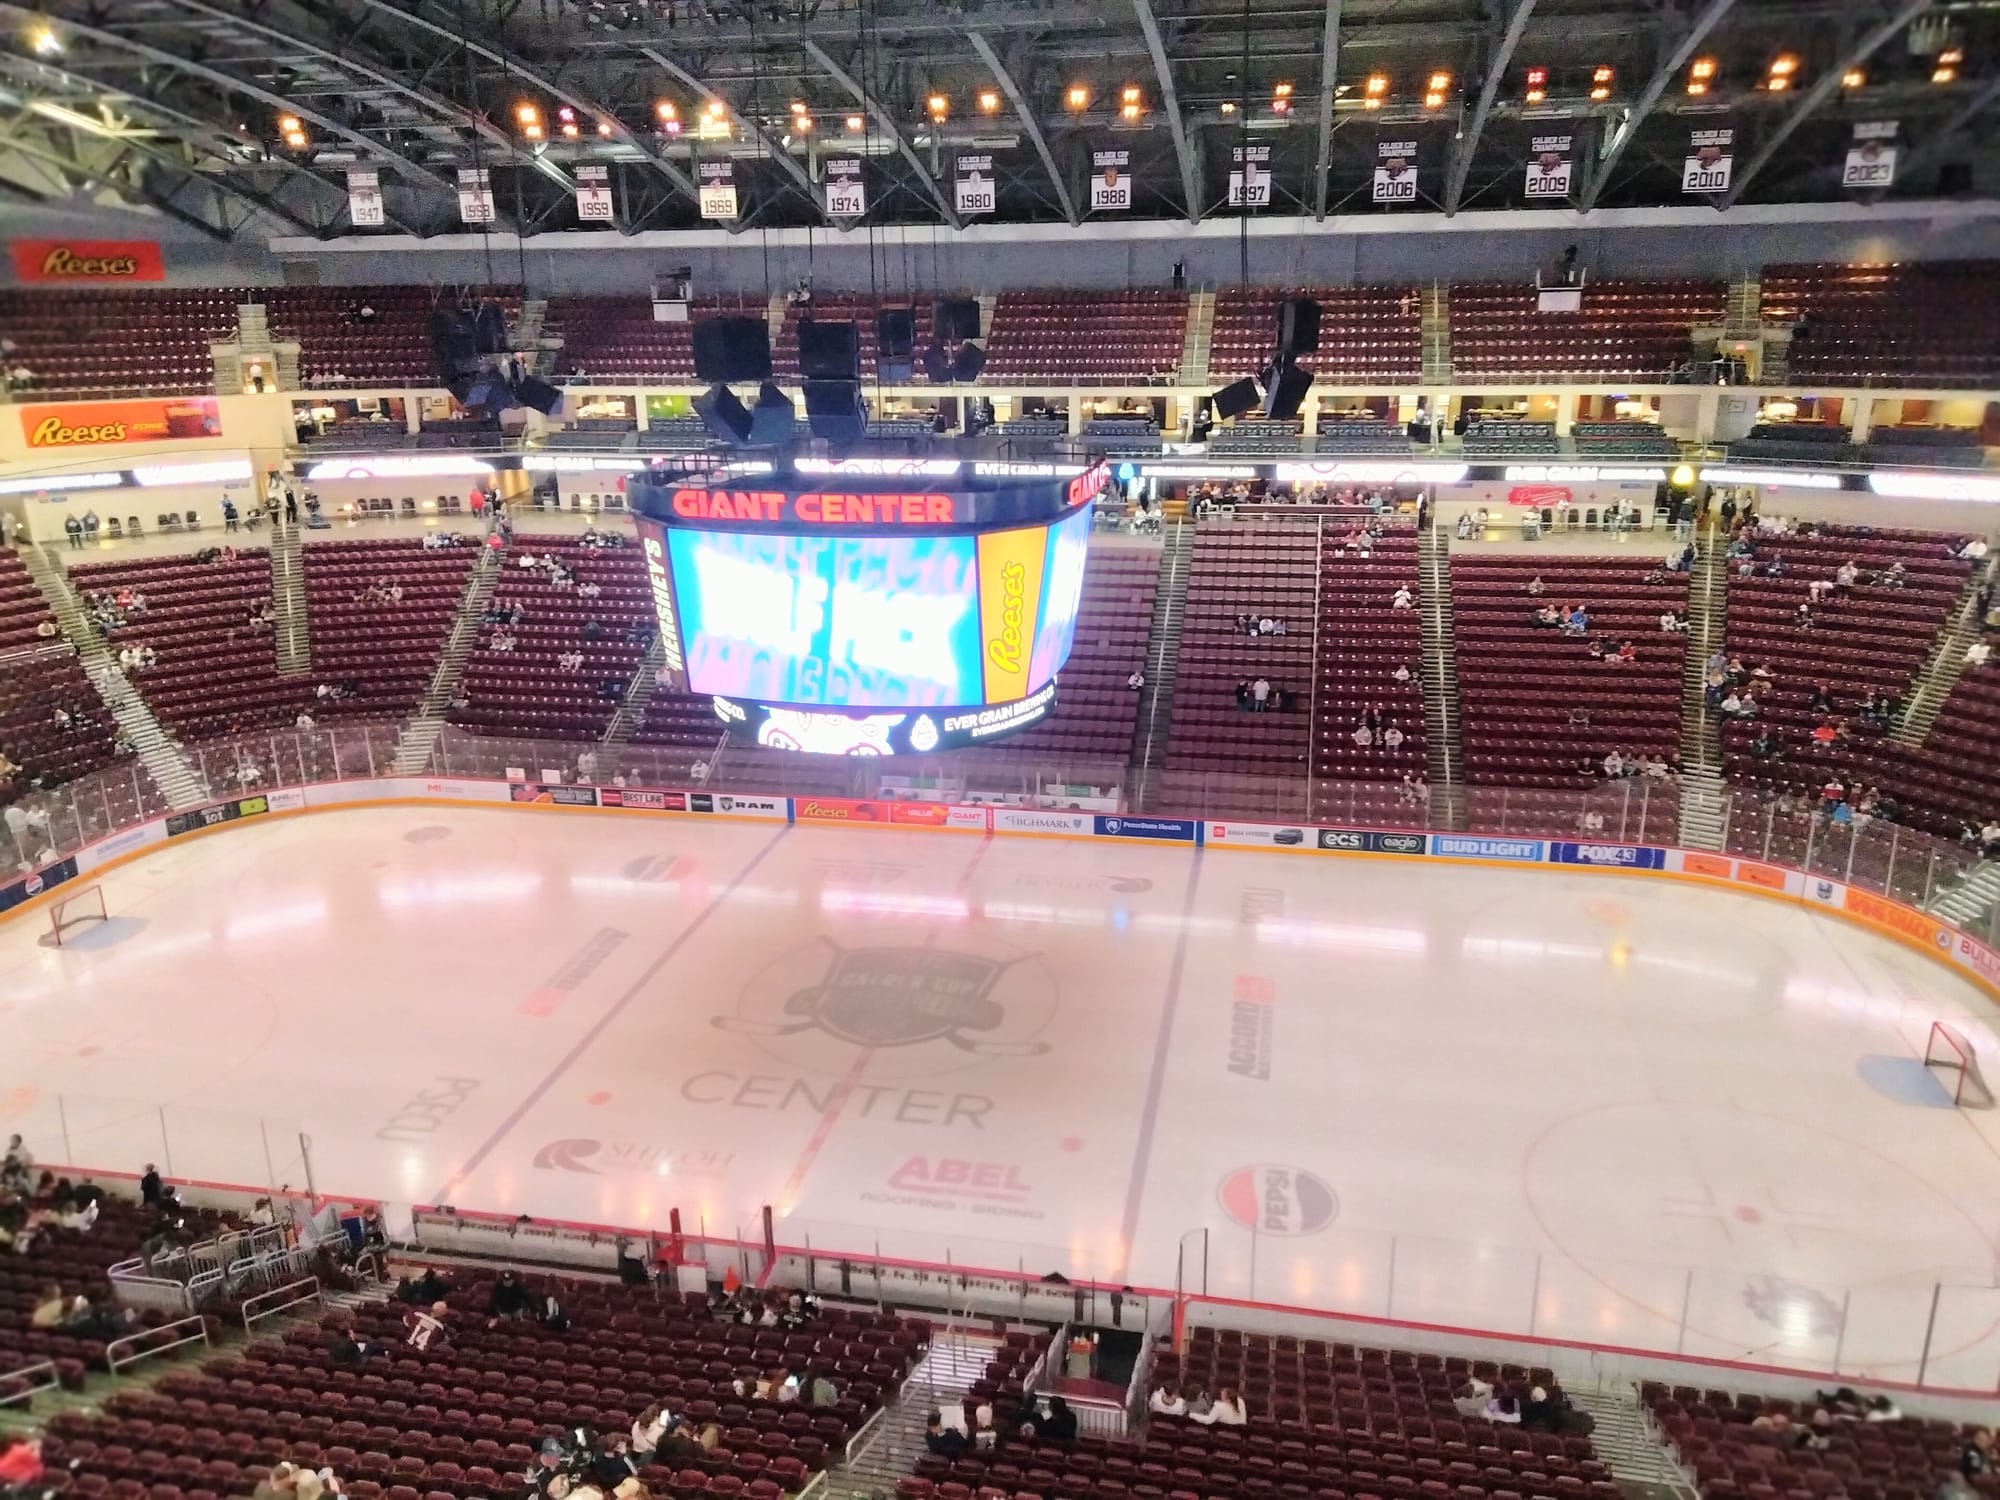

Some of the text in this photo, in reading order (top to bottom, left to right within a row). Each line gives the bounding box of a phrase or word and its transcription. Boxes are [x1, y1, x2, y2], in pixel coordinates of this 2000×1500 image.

[1687, 172, 1725, 188] 2010
[1847, 164, 1890, 181] 2023
[1376, 181, 1414, 198] 2006
[1528, 177, 1567, 193] 2009
[830, 197, 861, 212] 1974
[960, 195, 991, 209] 1980
[1095, 190, 1127, 205] 1988
[581, 202, 609, 216] 1959
[704, 199, 733, 214] 1969
[43, 247, 138, 275] Reese's
[33, 417, 127, 446] Reese's
[673, 489, 953, 523] GIANT CENTER
[644, 537, 684, 671] HERSHEY'S
[988, 561, 1026, 674] Reese's
[944, 713, 978, 732] EVER
[978, 705, 1014, 725] GRAIN
[623, 792, 664, 804] BEST LINE
[735, 801, 774, 811] RAM
[1010, 815, 1071, 829] HIGHMARK
[1158, 822, 1182, 832] Health
[1324, 834, 1418, 850] ecs eagle
[1441, 839, 1533, 858] BUD LIGHT
[680, 1070, 995, 1129] CENTER
[892, 1154, 1033, 1191] ABEL
[1264, 1168, 1290, 1232] PEPSI
[407, 1323, 432, 1351] 14
